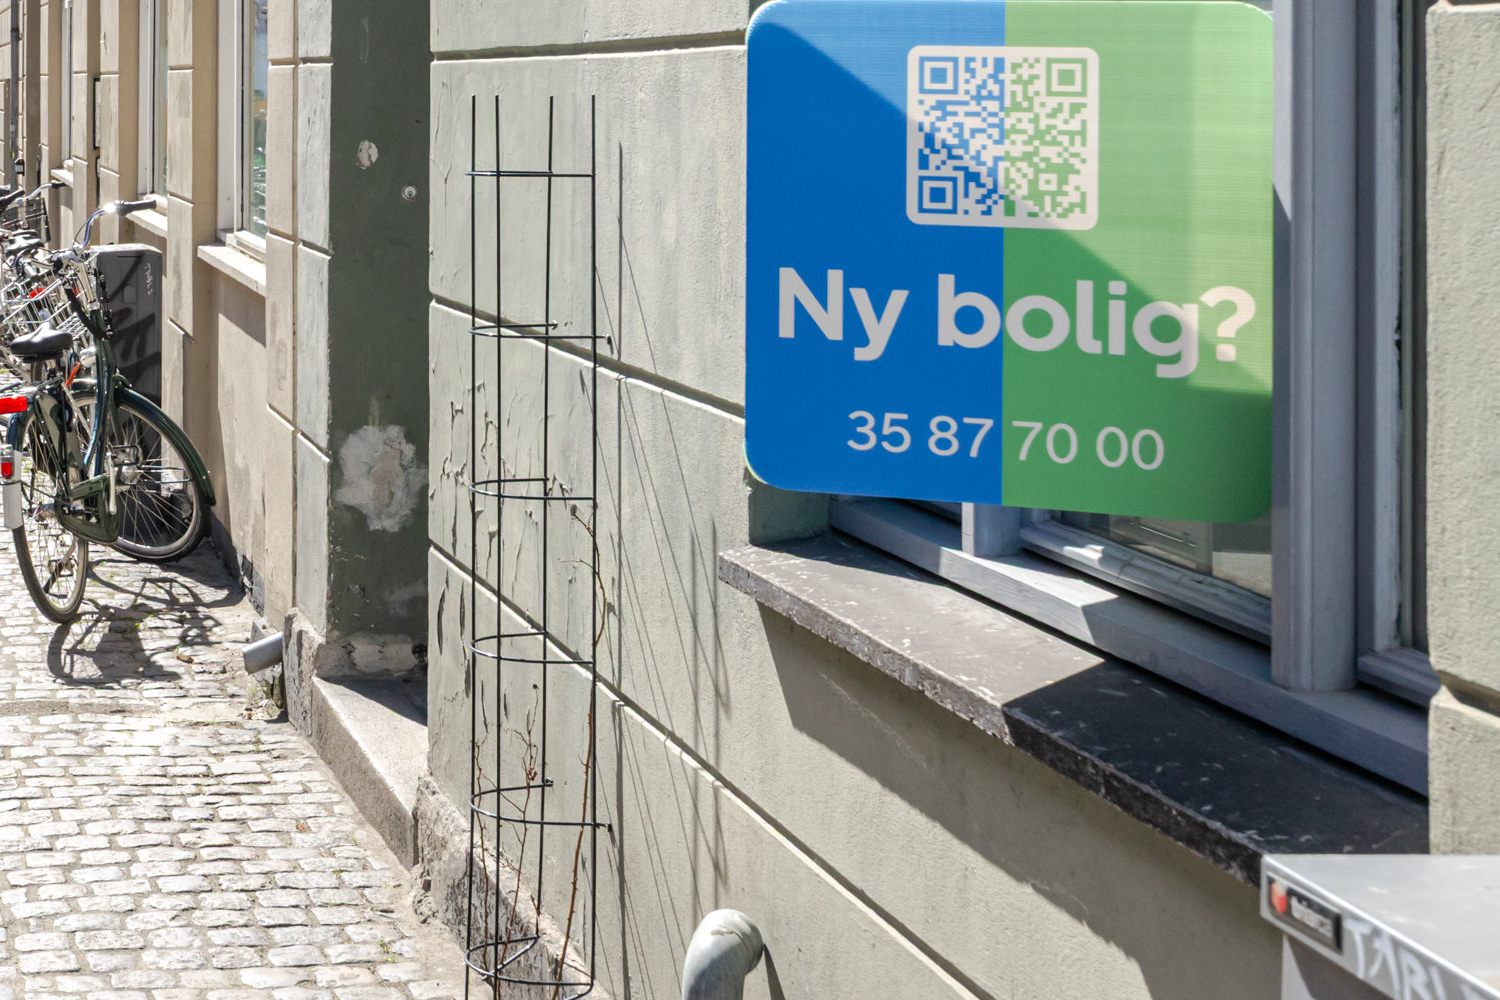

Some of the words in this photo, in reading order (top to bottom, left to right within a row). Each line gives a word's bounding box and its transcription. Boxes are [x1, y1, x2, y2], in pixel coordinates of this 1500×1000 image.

[778, 266, 910, 362] Ny
[937, 273, 1257, 379] bolig?
[846, 409, 912, 454] 35
[927, 415, 995, 458] 87
[1011, 420, 1079, 465] 70
[1095, 426, 1165, 471] 00
